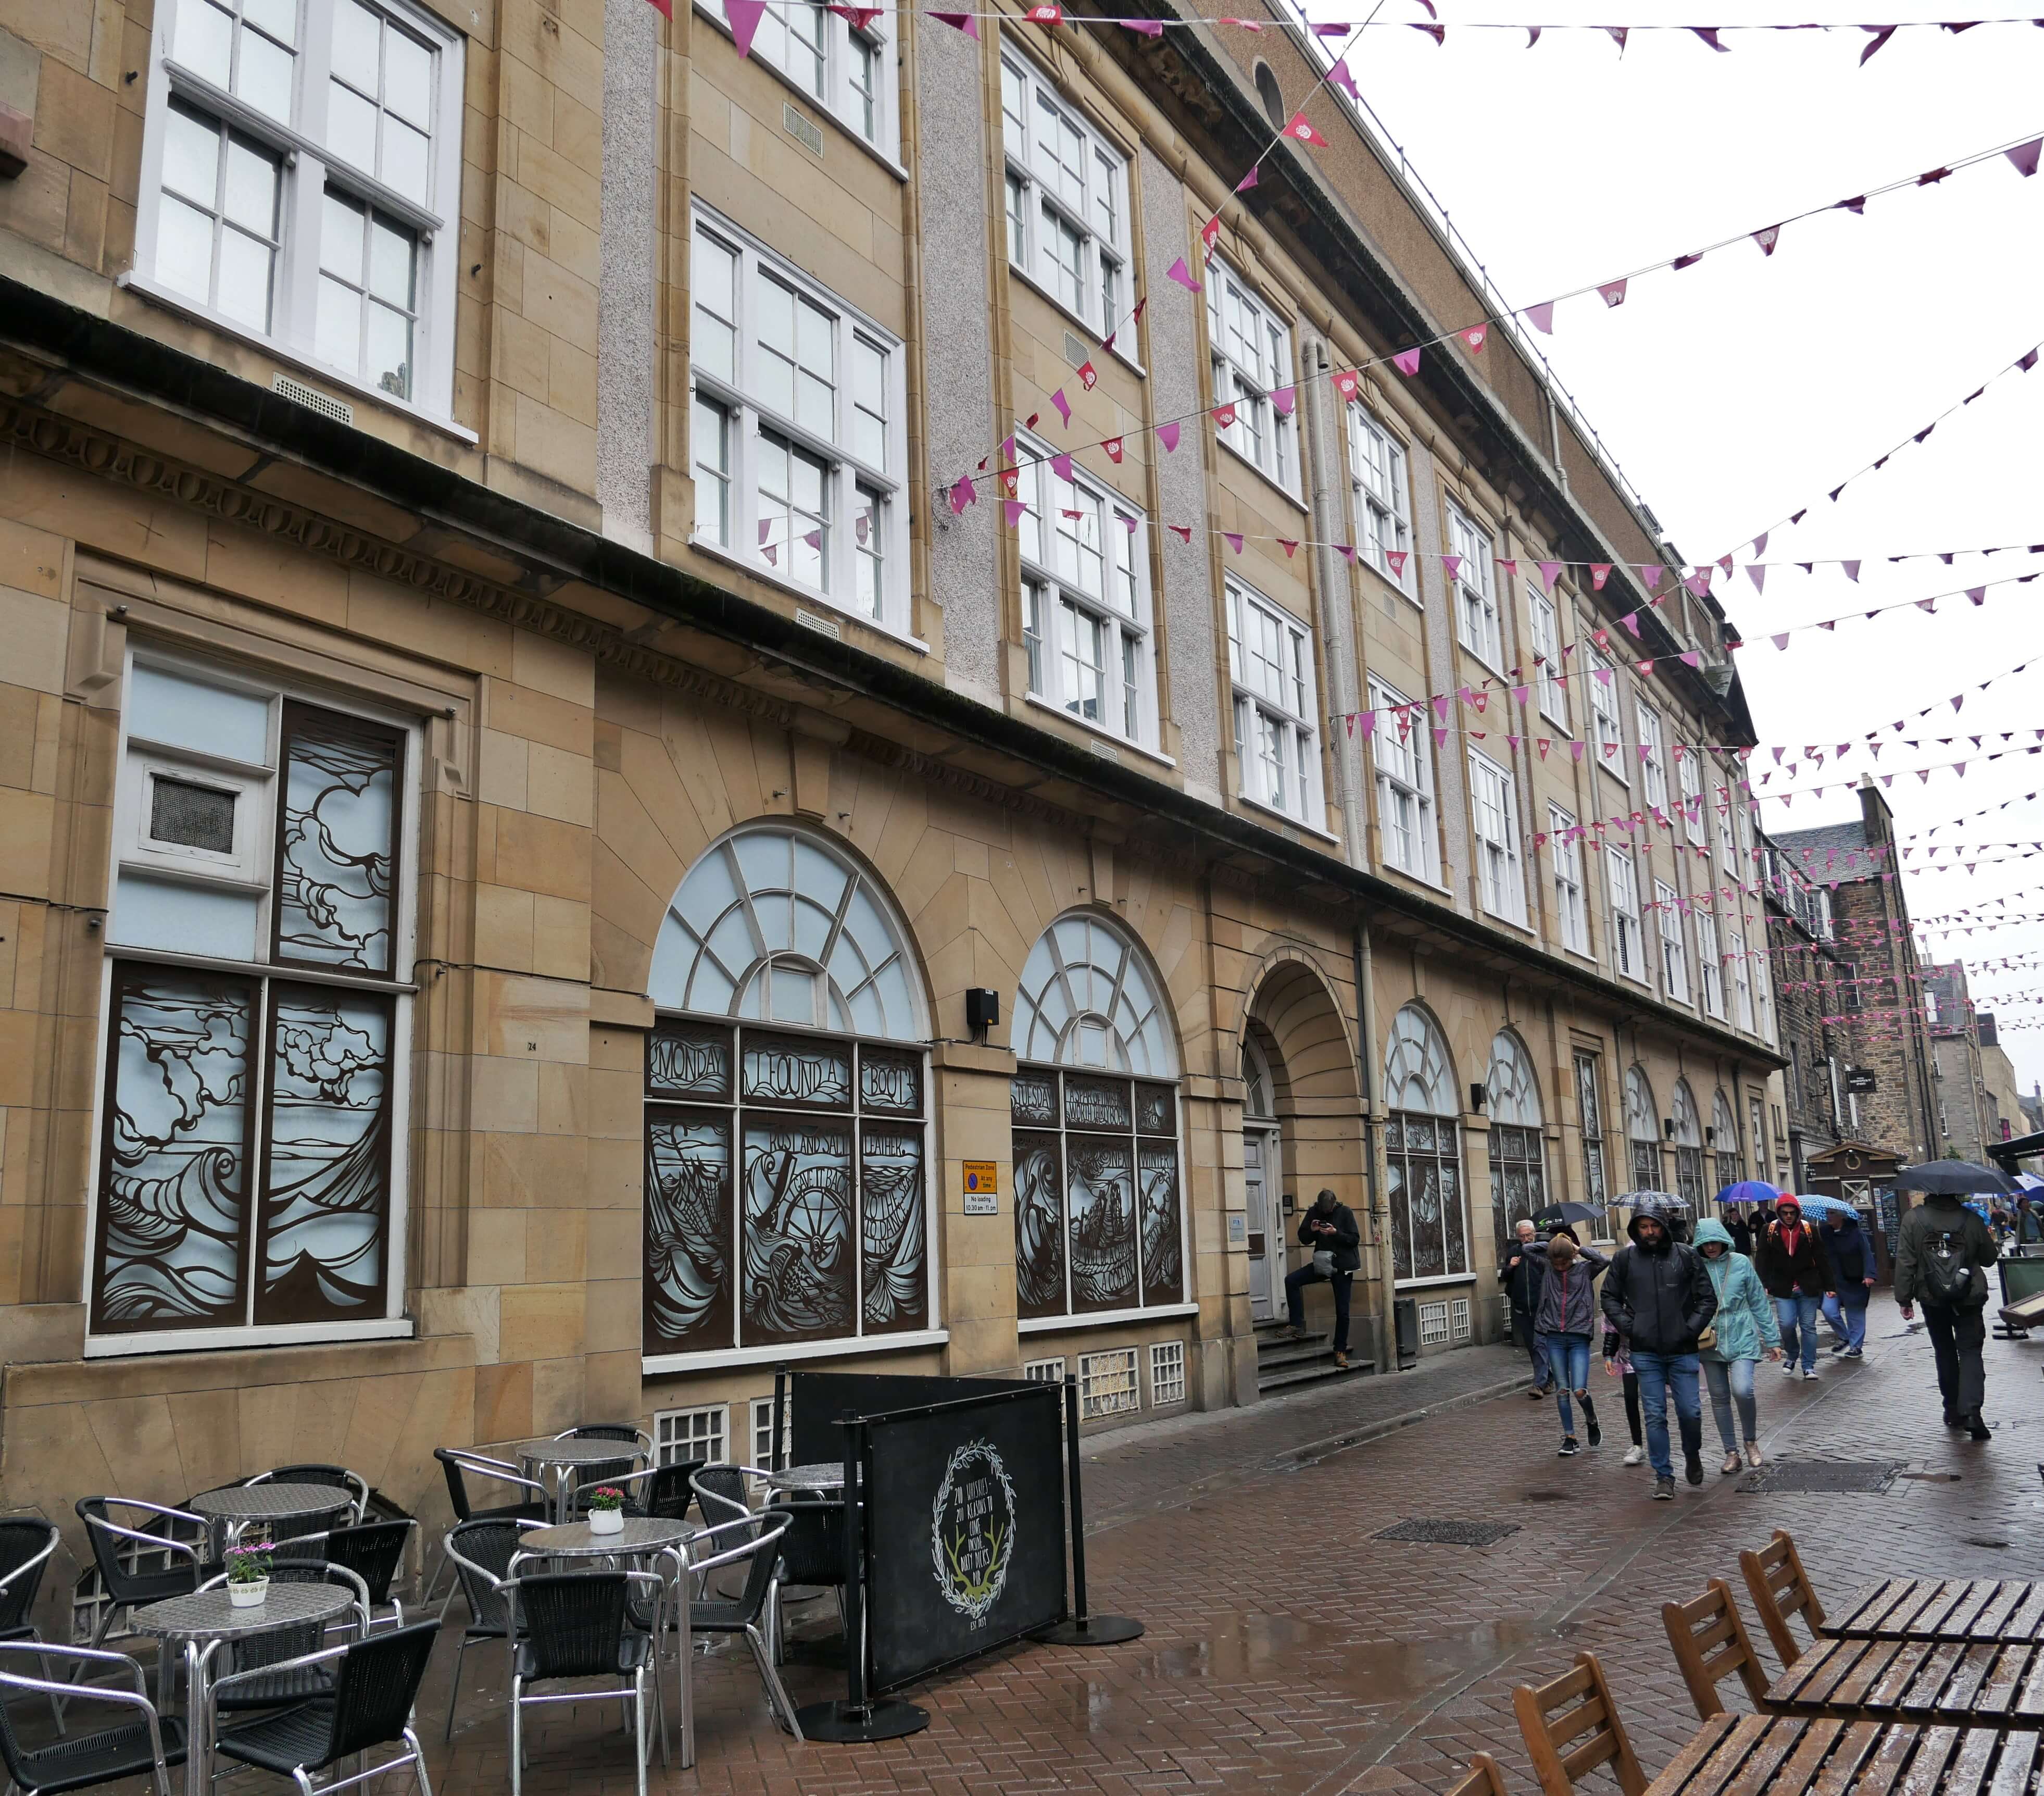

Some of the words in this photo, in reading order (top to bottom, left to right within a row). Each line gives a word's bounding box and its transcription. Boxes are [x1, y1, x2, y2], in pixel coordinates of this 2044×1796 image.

[528, 1042, 536, 1051] 24
[659, 1042, 721, 1081] MONDAY
[769, 1053, 822, 1098] FOUND
[827, 1058, 837, 1083] A
[1016, 1085, 1051, 1109] TUESDAY
[1076, 1088, 1092, 1104] SPAR
[1069, 1103, 1092, 1121] WORTH
[800, 1136, 820, 1155] AND
[794, 1169, 814, 1193] GAVE
[880, 1200, 908, 1239] DANCE
[955, 1486, 963, 1505] 200
[967, 1477, 988, 1501] WHISKIES
[967, 1498, 986, 1519] REASONS
[987, 1495, 993, 1512] TO
[970, 1518, 981, 1536] COME
[961, 1552, 973, 1573] DIRTY
[972, 1569, 982, 1587] PUB
